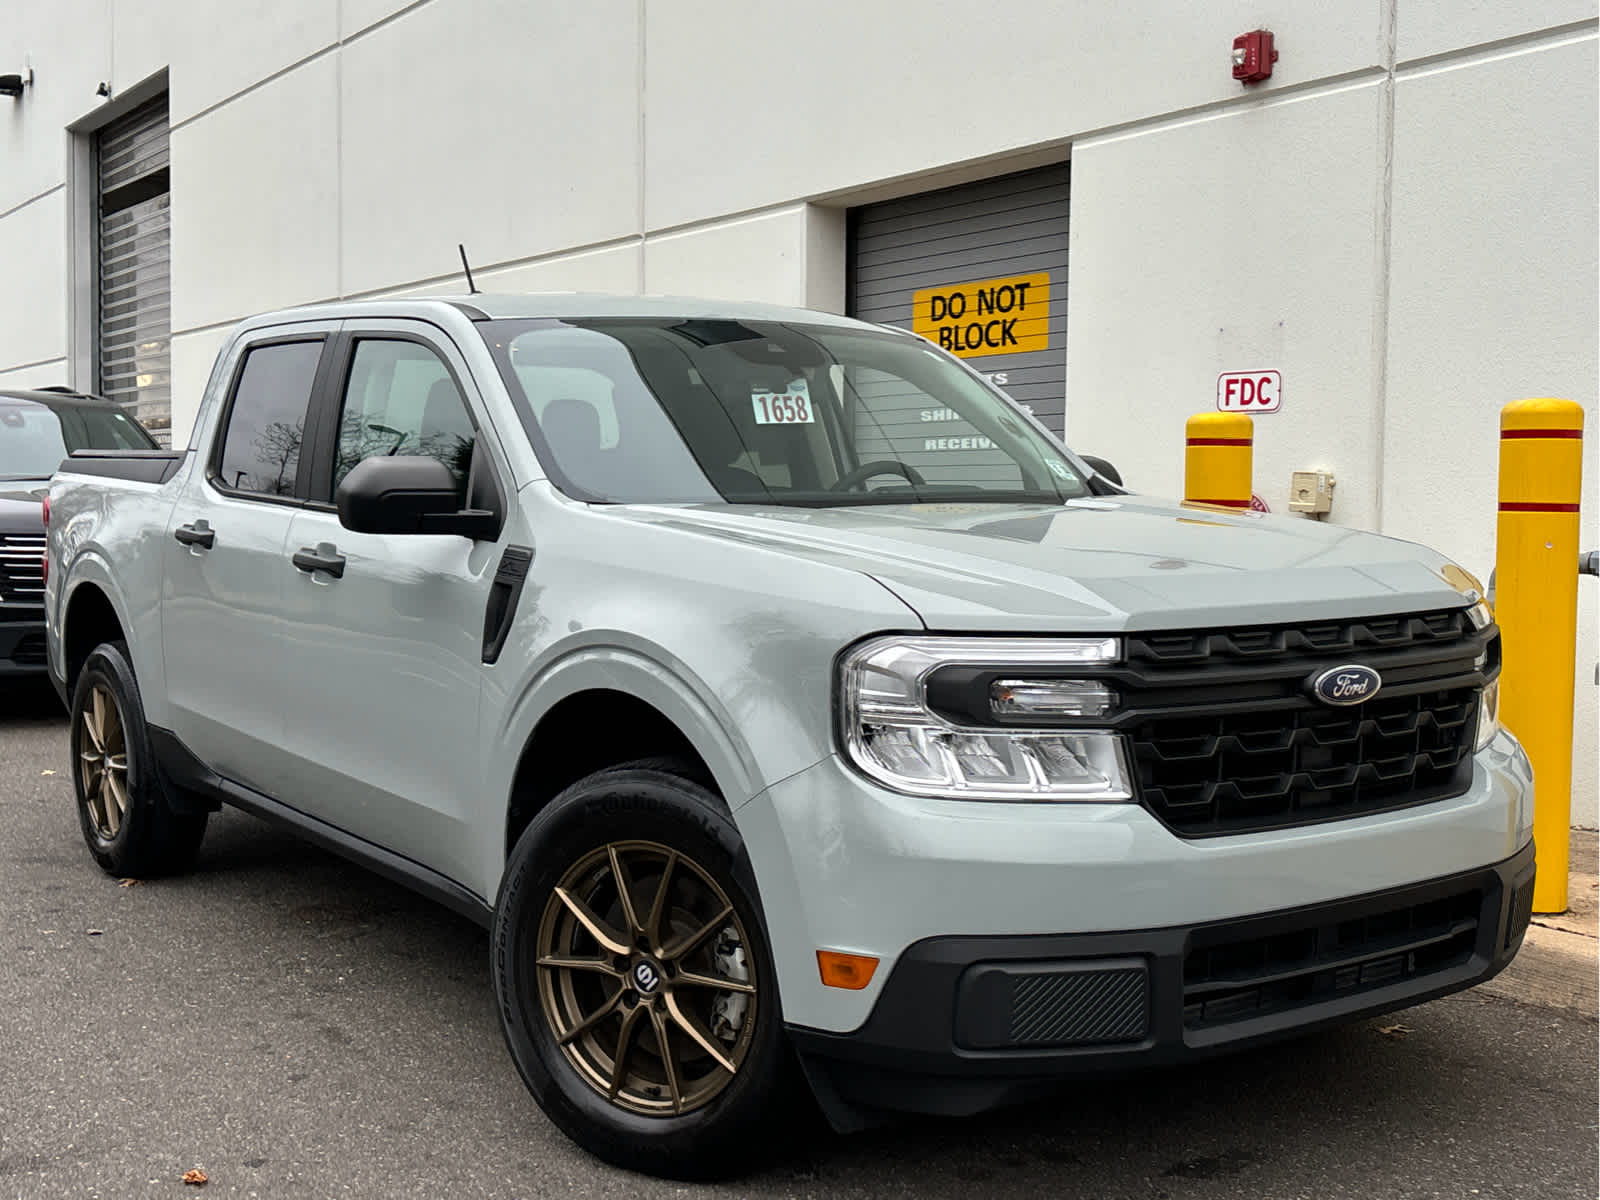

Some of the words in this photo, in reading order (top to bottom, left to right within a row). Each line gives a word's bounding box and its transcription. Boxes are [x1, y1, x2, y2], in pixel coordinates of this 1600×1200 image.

[931, 292, 966, 322] DO
[978, 283, 1030, 316] NOT
[939, 318, 1018, 351] BLOCK
[1225, 377, 1272, 406] FDC
[758, 396, 808, 422] 1658
[1333, 674, 1369, 697] Ford
